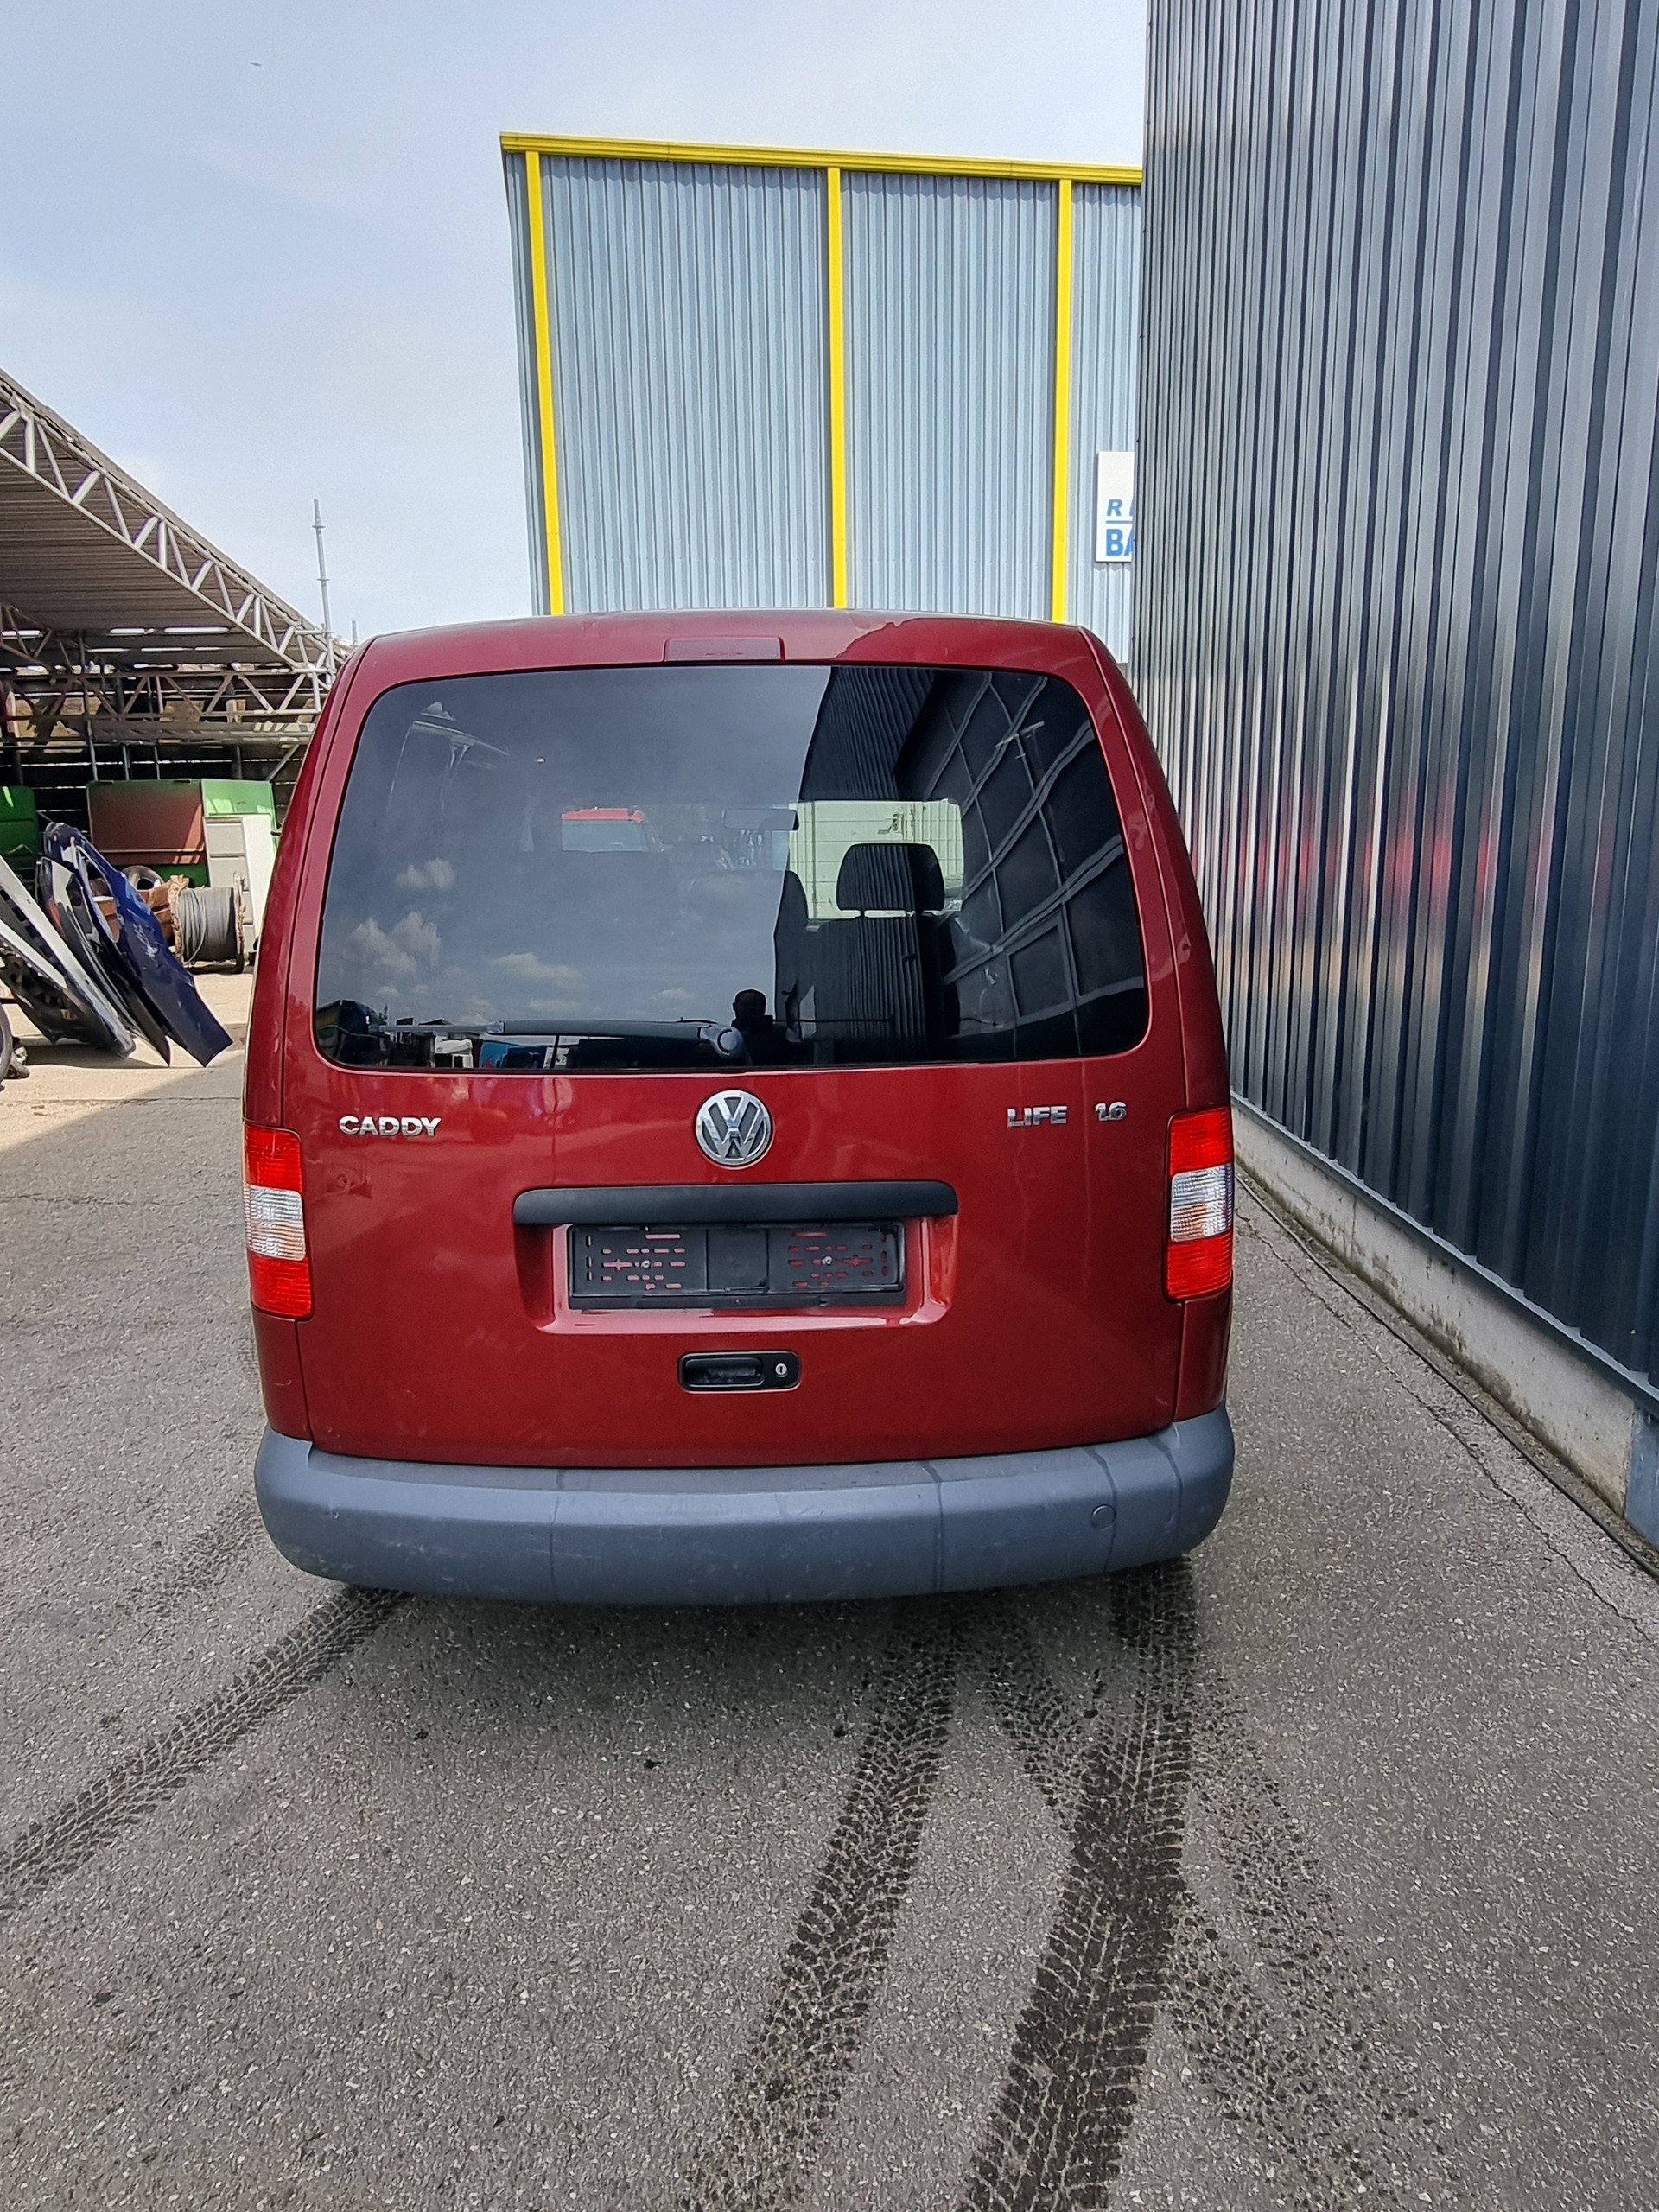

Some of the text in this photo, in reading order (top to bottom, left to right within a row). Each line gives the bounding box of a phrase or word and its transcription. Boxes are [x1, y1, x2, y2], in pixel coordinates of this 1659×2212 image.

[339, 1115, 442, 1137] CADDY
[696, 1090, 772, 1166] VW
[1007, 1105, 1068, 1128] LIFE
